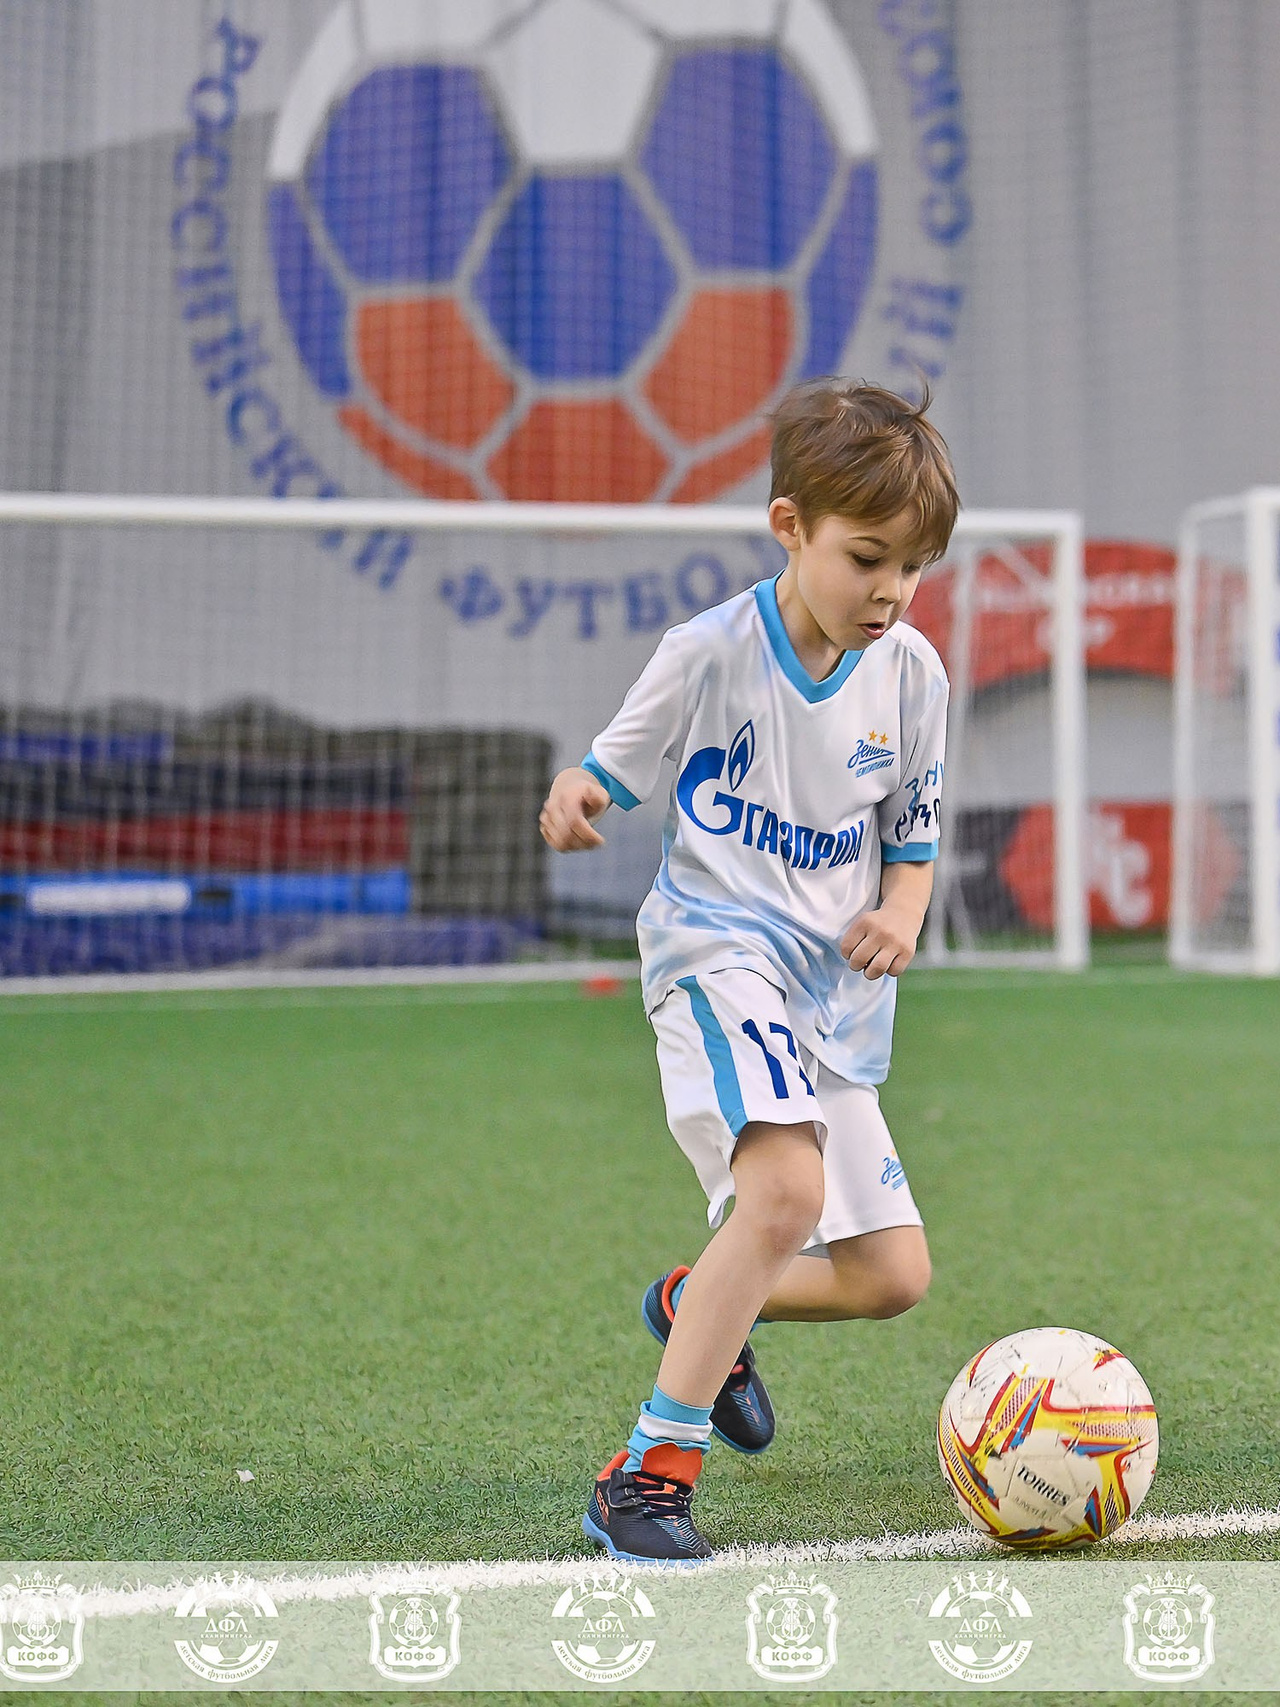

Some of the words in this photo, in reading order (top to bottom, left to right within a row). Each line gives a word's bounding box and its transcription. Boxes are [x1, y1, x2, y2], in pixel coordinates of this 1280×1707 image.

[742, 801, 865, 871] ГАЗПРОМ
[741, 1018, 816, 1100] 17
[1017, 1463, 1071, 1507] TORRES
